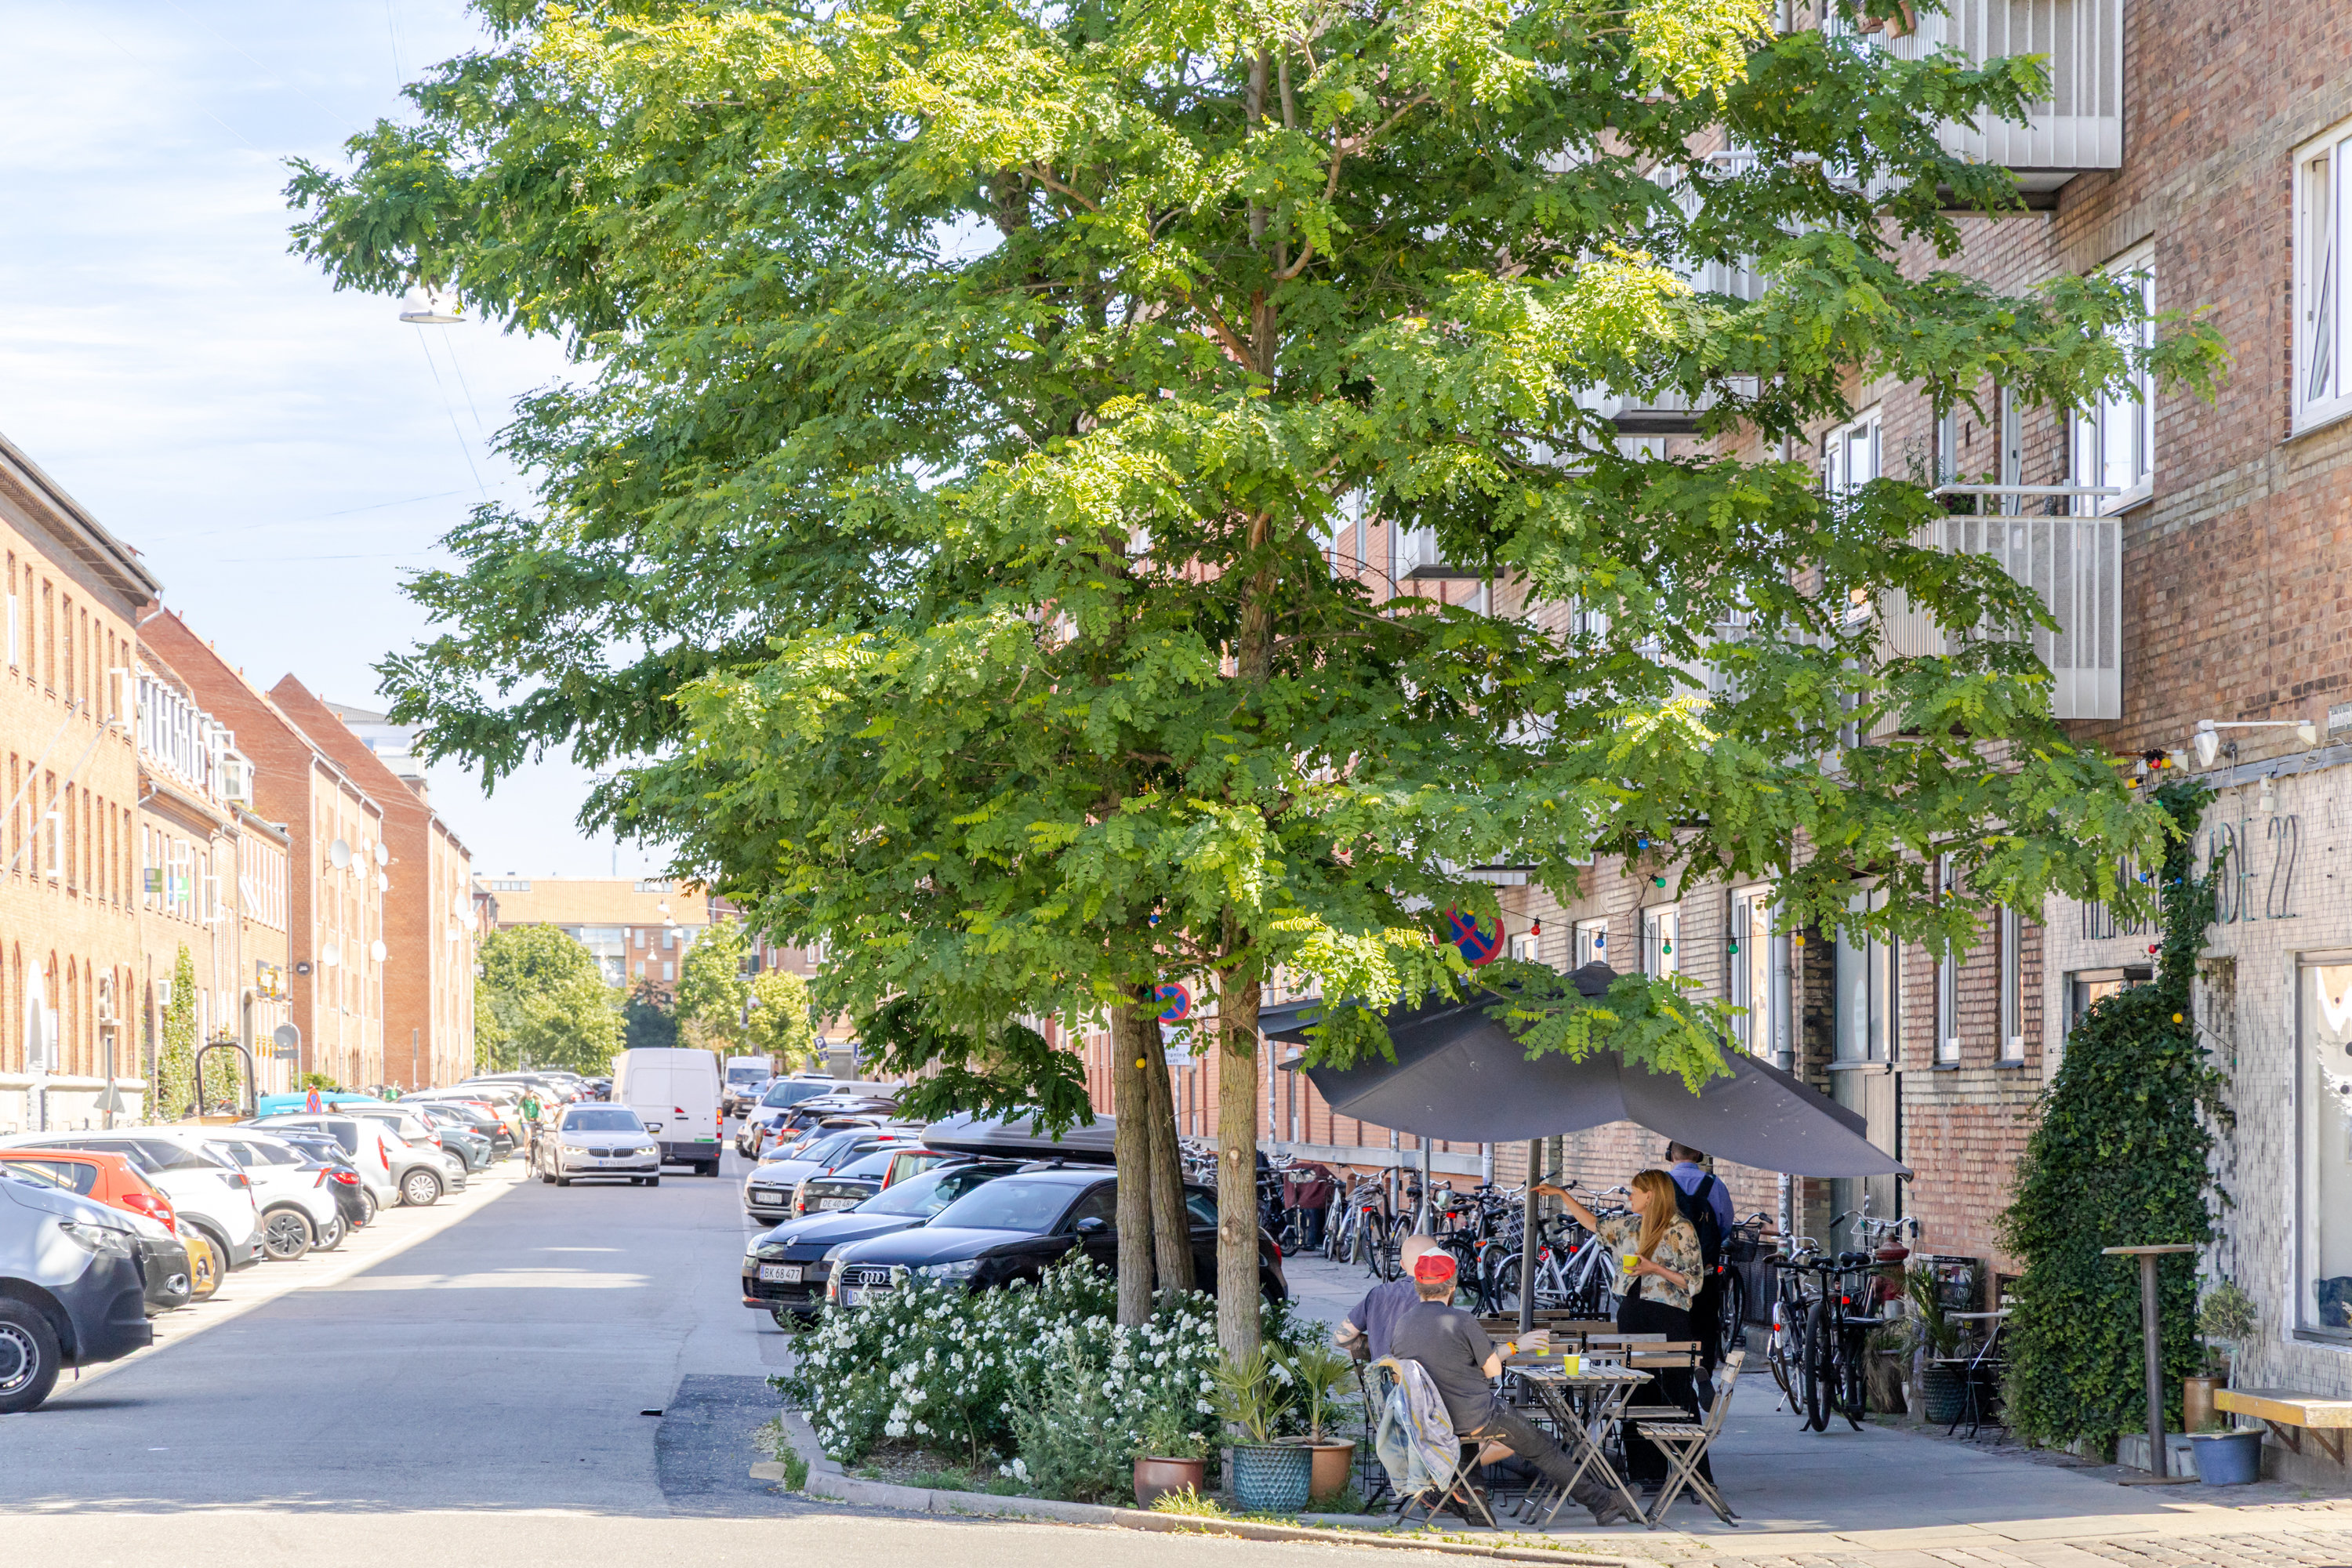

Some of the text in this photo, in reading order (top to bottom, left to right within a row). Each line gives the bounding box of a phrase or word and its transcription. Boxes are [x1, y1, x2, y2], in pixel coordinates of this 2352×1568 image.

[2267, 815, 2296, 919] 22
[815, 1037, 824, 1050] P
[764, 1268, 800, 1279] BK 68 477
